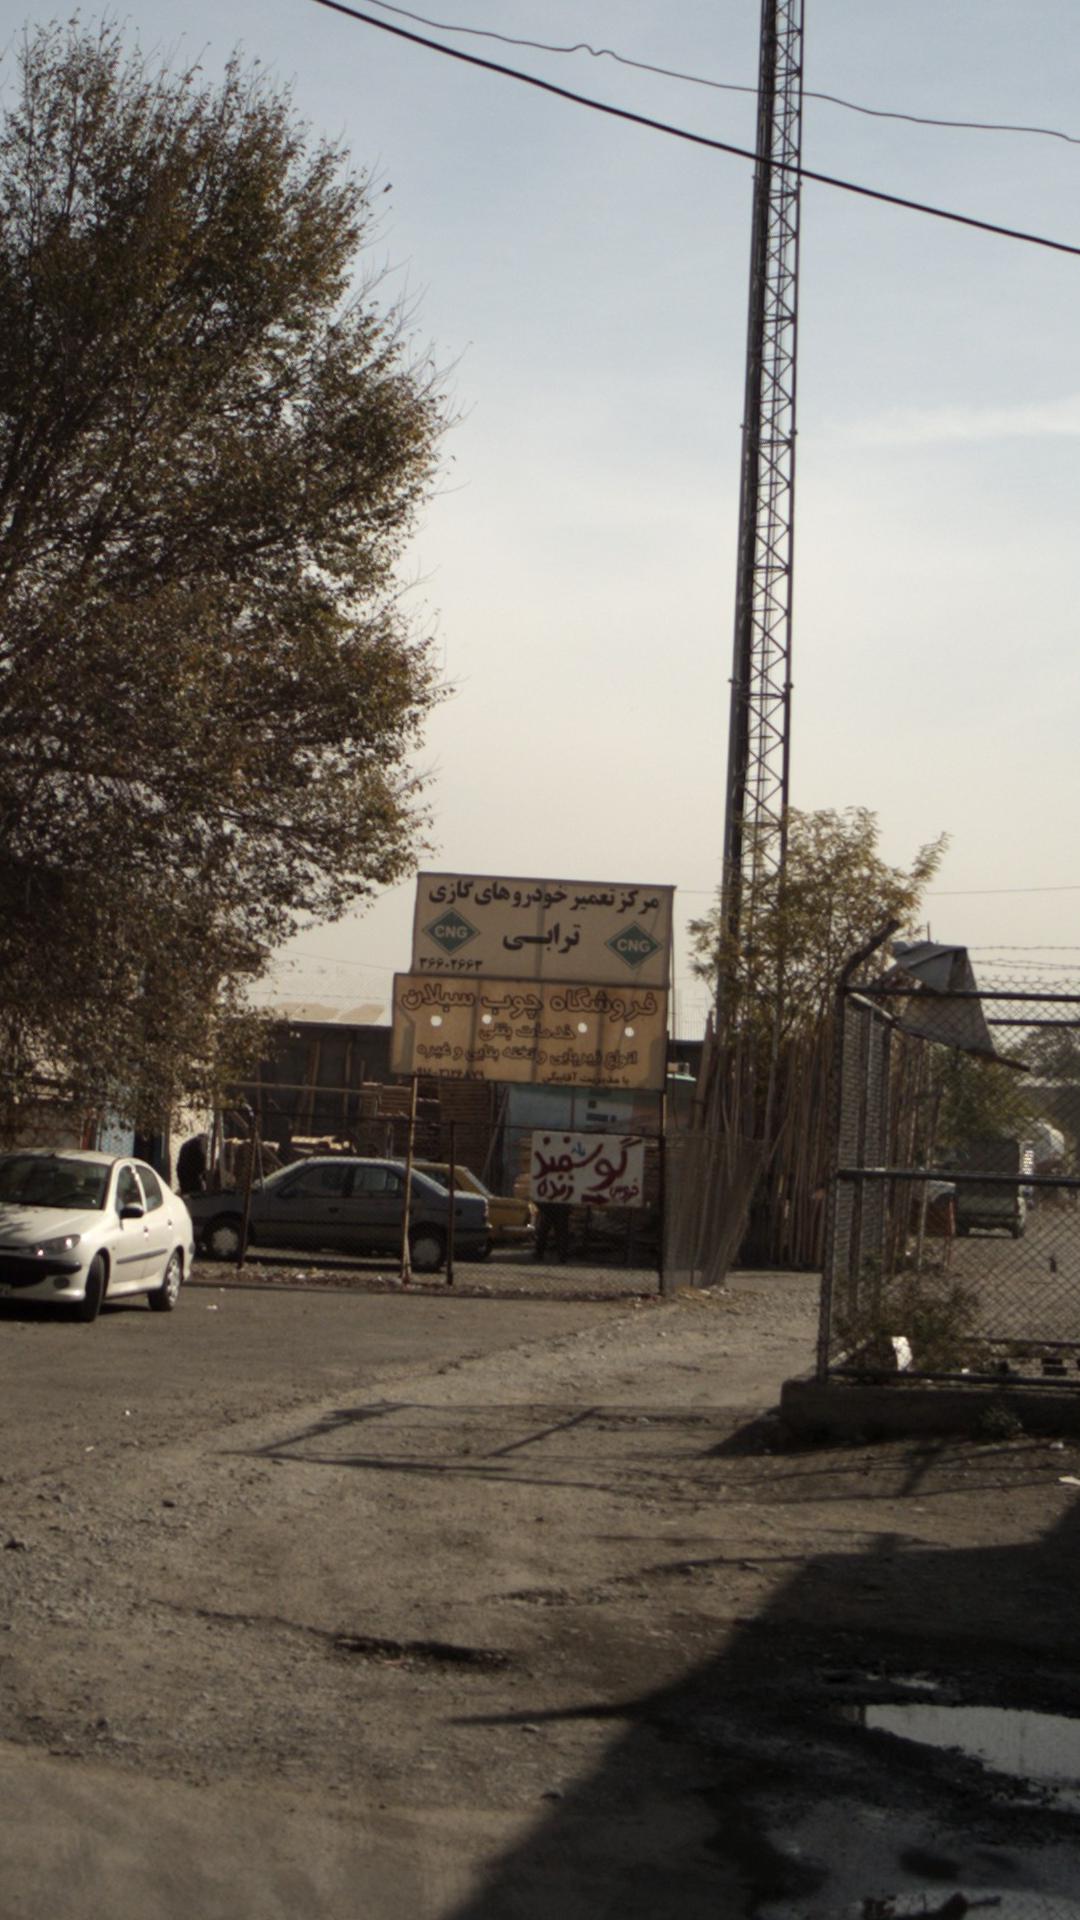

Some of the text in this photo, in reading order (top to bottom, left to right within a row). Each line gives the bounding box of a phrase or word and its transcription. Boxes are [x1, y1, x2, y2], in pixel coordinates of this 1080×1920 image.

[428, 880, 474, 904] گازی
[569, 886, 615, 912] تعمیر
[616, 890, 659, 915] مرکز
[433, 924, 468, 939] CNG
[503, 922, 580, 954] ترابی
[617, 938, 652, 953] CNG
[400, 983, 658, 1022] فروشگاه چوب سبلان
[515, 1022, 576, 1041] خدمات
[453, 1046, 464, 1062] و
[533, 1136, 642, 1191] گوسفند
[536, 1174, 574, 1201] زنده
